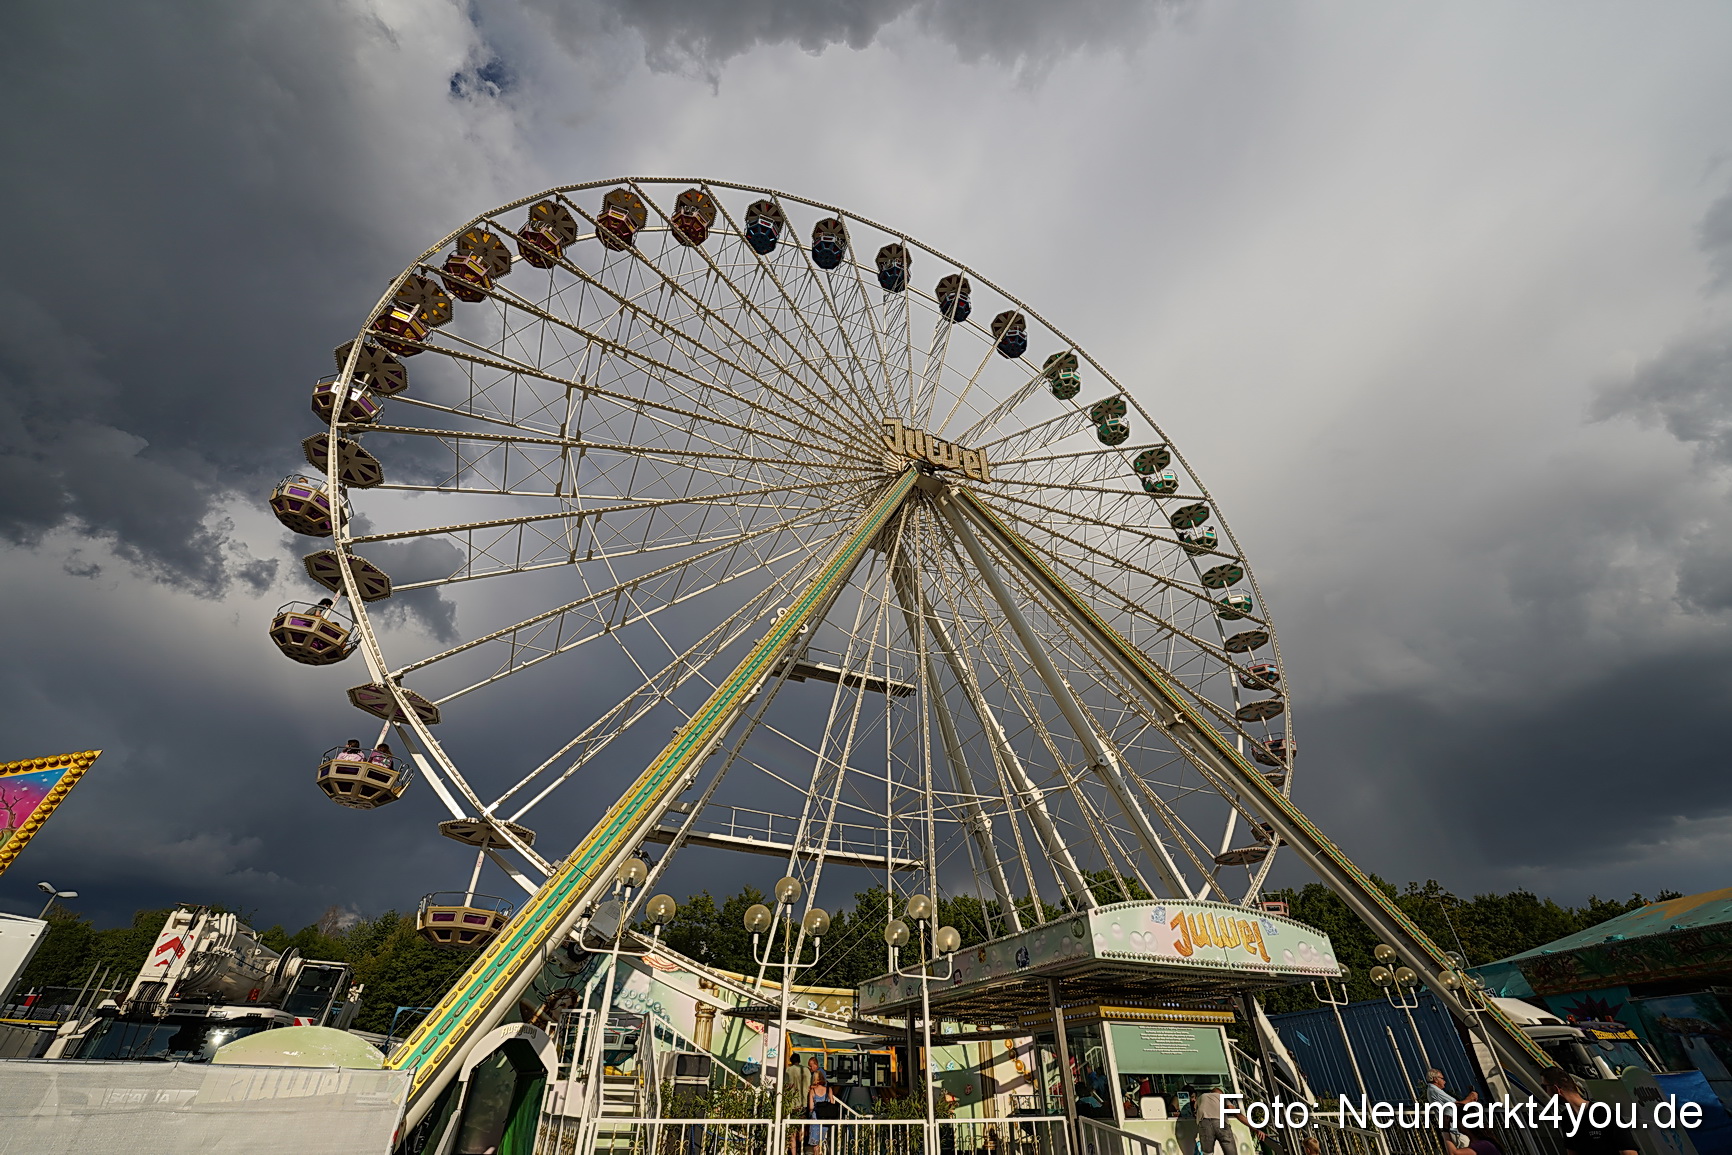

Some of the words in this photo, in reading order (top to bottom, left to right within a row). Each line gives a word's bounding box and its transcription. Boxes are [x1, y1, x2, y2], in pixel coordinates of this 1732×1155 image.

[881, 417, 992, 484] Juwel
[1170, 910, 1271, 963] Juwel
[500, 1024, 538, 1039] Ausgang
